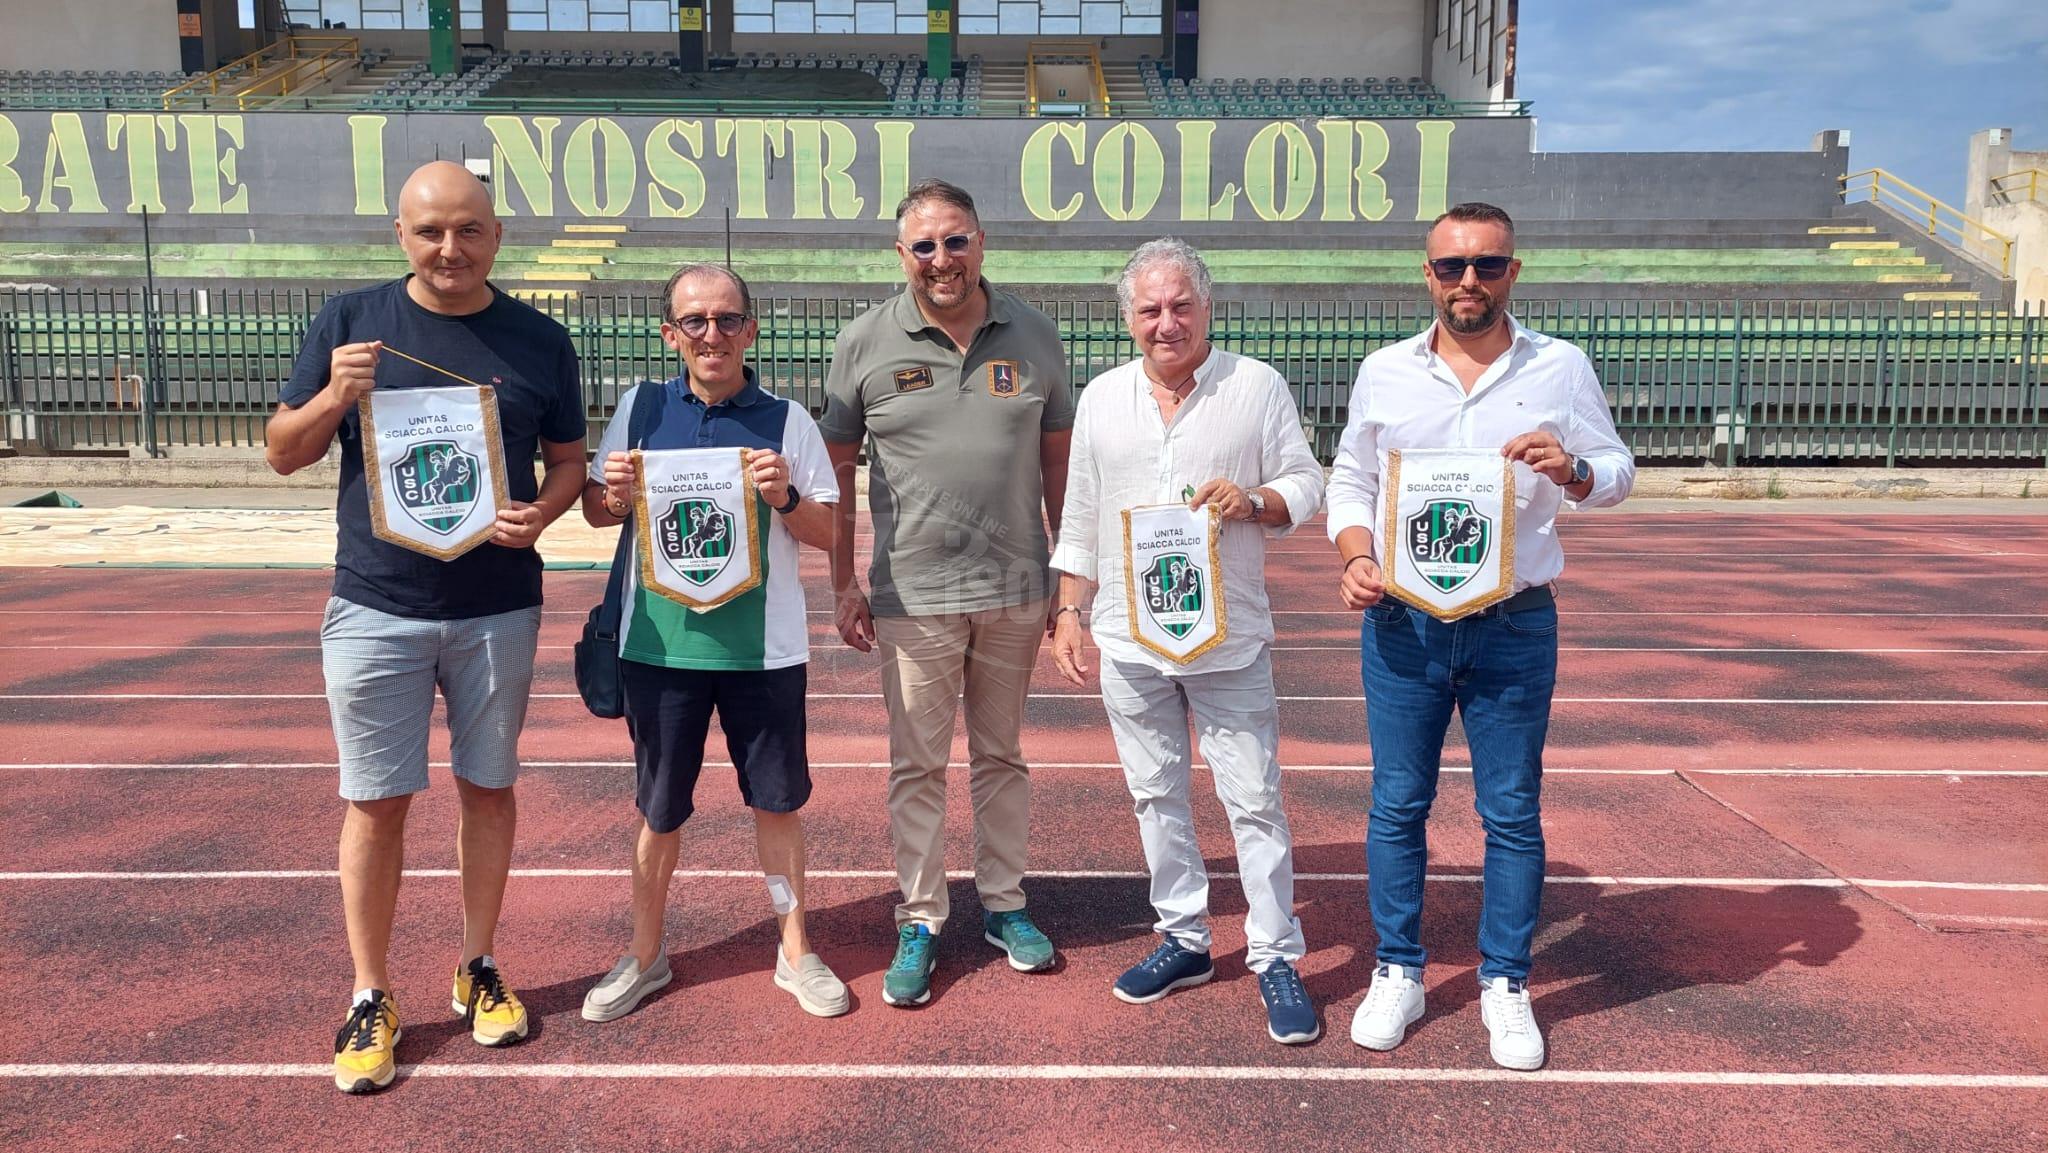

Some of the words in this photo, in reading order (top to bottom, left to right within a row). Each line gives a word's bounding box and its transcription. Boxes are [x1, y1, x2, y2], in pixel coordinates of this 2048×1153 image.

[347, 115, 388, 216] I
[483, 115, 915, 221] NOSTRI
[1019, 119, 1456, 222] COLORI
[408, 414, 448, 426] UNITAS
[384, 425, 433, 439] SCIACCA
[435, 423, 474, 434] CALCIO
[672, 471, 709, 482] UNITAS
[1431, 472, 1470, 481] UNITAS
[651, 484, 695, 494] SCIACCA
[696, 481, 732, 491] CALCIO
[1407, 483, 1453, 492] SCIACCA
[1454, 483, 1494, 493] CLCIO
[1154, 527, 1184, 538] UNITAS
[1136, 540, 1174, 551] SCIACCA
[1175, 536, 1201, 547] CALCIO
